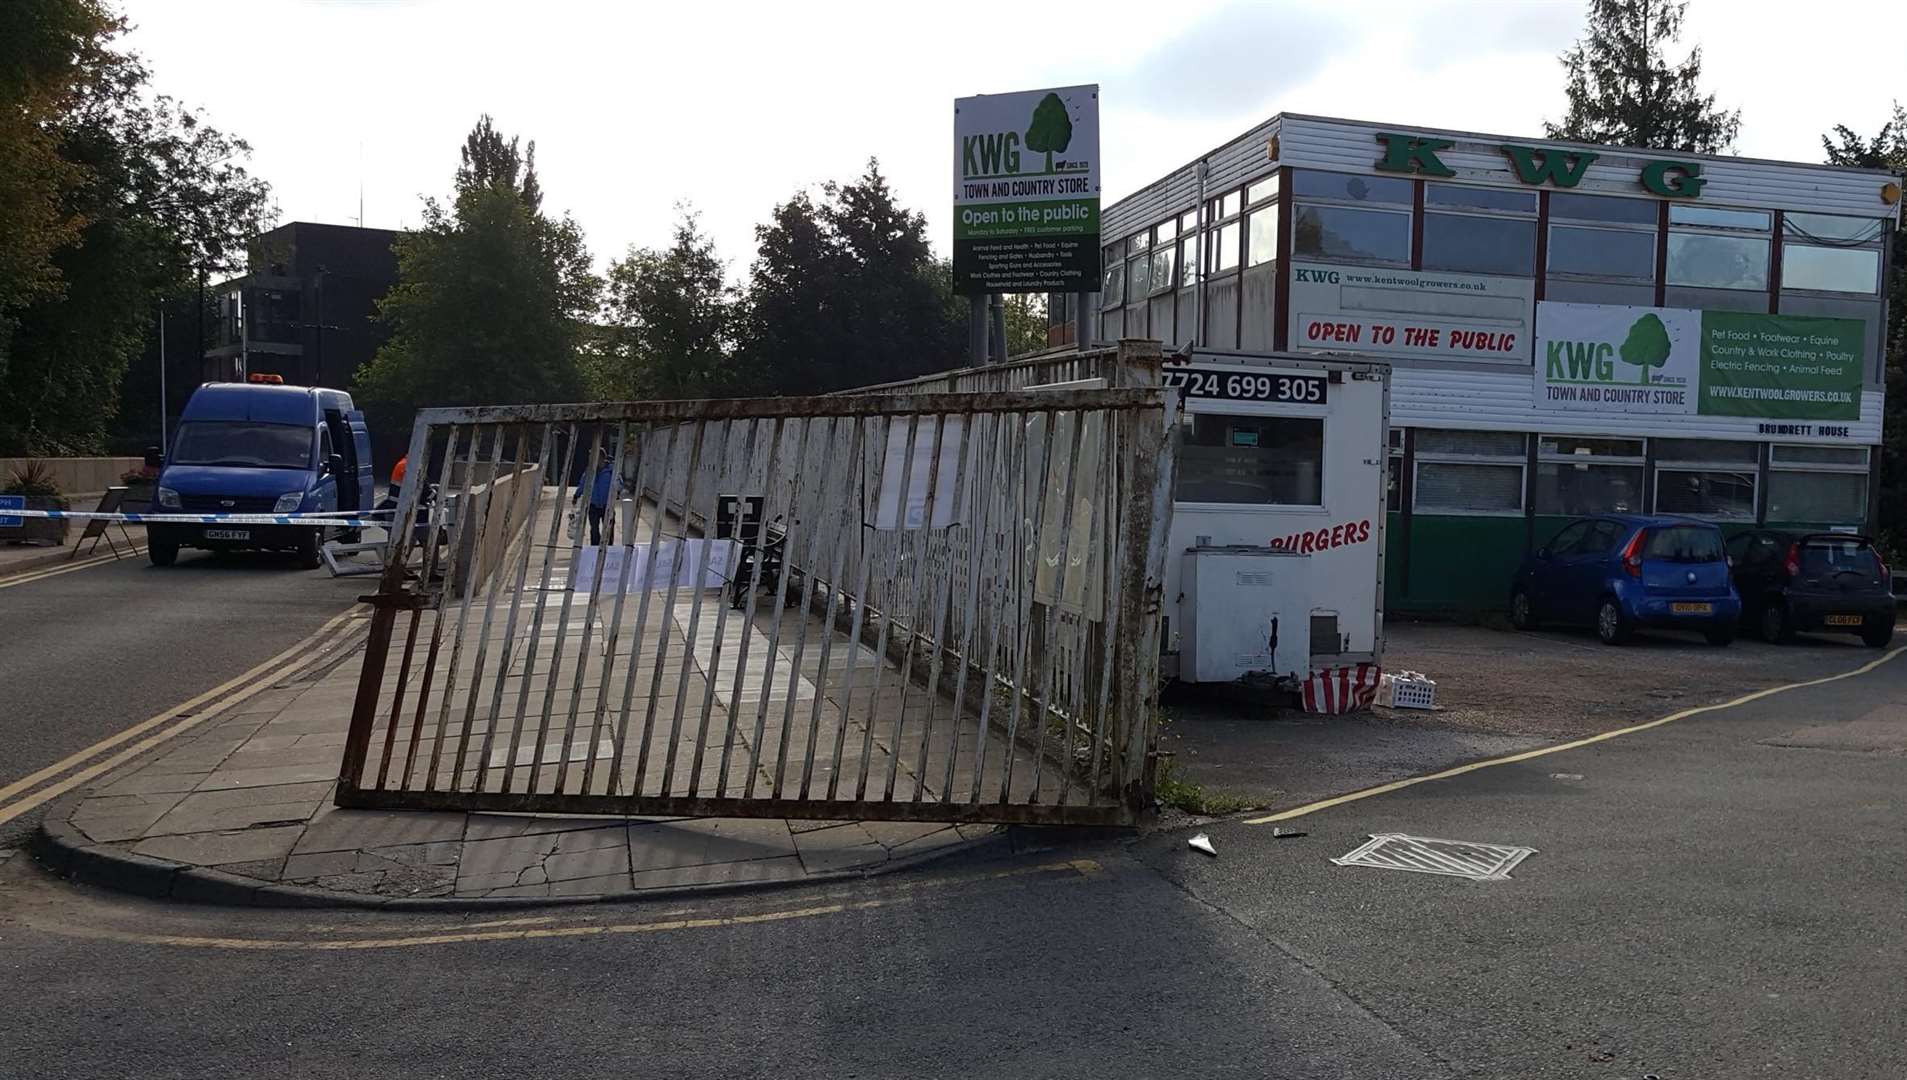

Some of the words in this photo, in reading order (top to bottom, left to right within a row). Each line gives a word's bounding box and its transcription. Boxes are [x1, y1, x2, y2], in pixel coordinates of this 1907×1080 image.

[963, 131, 1020, 176] KWG
[964, 184, 989, 199] TOWN
[992, 182, 1009, 197] AND
[1012, 180, 1055, 196] COUNTRY
[1058, 178, 1088, 193] STORE
[962, 209, 998, 226] Open
[1002, 208, 1014, 222] to
[1019, 206, 1040, 220] the
[1044, 204, 1088, 224] public
[1295, 268, 1340, 284] KWG
[1347, 274, 1486, 291] www.kentwoolgrowers.co.uk
[1307, 321, 1361, 343] OPEN
[1372, 325, 1395, 345] TO
[1404, 328, 1440, 347] THE
[1449, 330, 1516, 352] PUBLIC
[1712, 329, 1726, 339] Pet
[1728, 330, 1750, 340] Food
[1760, 332, 1800, 343] Footwear
[1810, 336, 1839, 346] Equine
[1546, 341, 1613, 381] KWG
[1712, 345, 1746, 356] Country
[1749, 347, 1755, 356] &
[1758, 348, 1778, 357] Work
[1780, 349, 1816, 361] Clothing
[1826, 351, 1854, 362] Poultry
[1711, 360, 1742, 370] Electric
[1745, 362, 1780, 374] Fencing
[1789, 365, 1818, 374] Animal
[1820, 366, 1842, 375] Feed
[1227, 375, 1270, 398] 699
[1278, 378, 1320, 401] 305
[1546, 386, 1576, 401] TOWN
[1579, 388, 1600, 402] AND
[1604, 388, 1650, 404] COUNTRY
[1653, 390, 1685, 405] STORE
[1710, 386, 1852, 403] WWW.KENTWOOLGROWERS.CO.UK
[1759, 423, 1812, 436] BRUNDRETT
[1818, 426, 1849, 437] HOUSE
